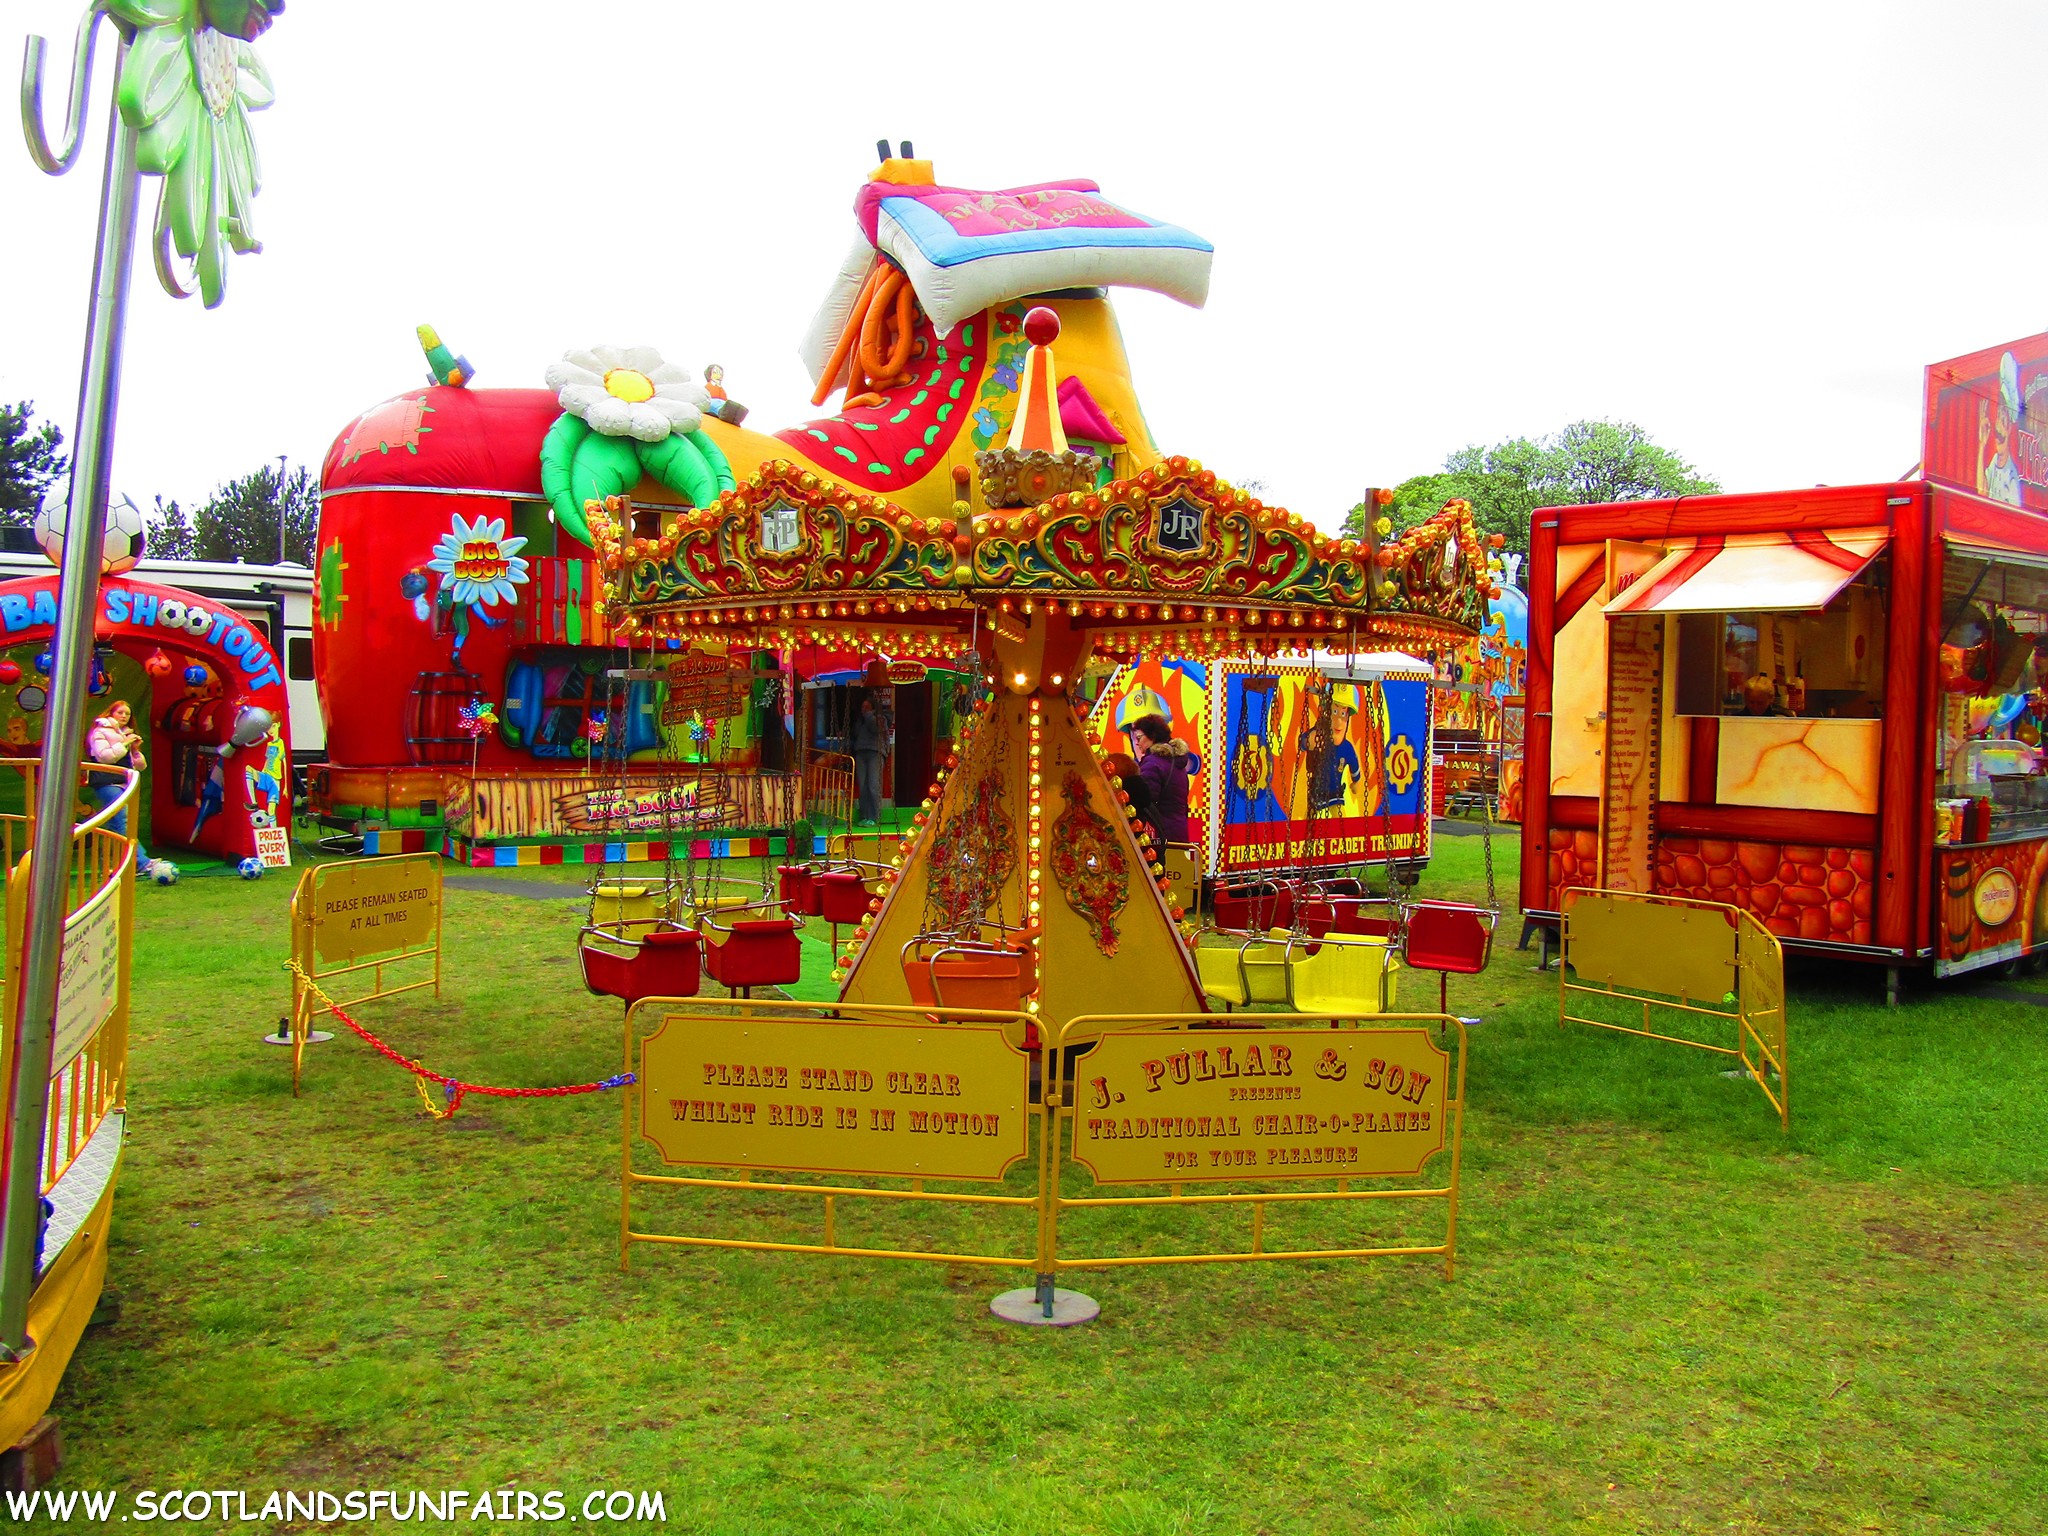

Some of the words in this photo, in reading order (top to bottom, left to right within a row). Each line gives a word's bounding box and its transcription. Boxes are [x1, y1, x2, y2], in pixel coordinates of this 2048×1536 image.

[463, 542, 499, 561] BIG
[454, 560, 510, 579] BOOT
[589, 801, 630, 821] BIG
[636, 780, 699, 815] BOOT
[628, 814, 660, 829] FUN
[258, 830, 284, 840] PRIZE
[258, 842, 286, 853] EVERY
[1229, 842, 1285, 864] FIREMAN
[1330, 836, 1366, 855] CADET
[264, 854, 286, 866] TIME
[326, 900, 359, 914] PLEASE
[362, 892, 396, 908] REMAIN
[398, 887, 428, 903] SEATED
[350, 918, 362, 931] AT
[365, 915, 381, 928] ALL
[384, 910, 408, 924] TIMES
[703, 1063, 788, 1088] PLEASE
[799, 1068, 874, 1093] STAND
[886, 1071, 962, 1096] CLEAR
[1089, 1076, 1126, 1109] J.
[1141, 1044, 1293, 1092] PULLAR
[1313, 1048, 1347, 1082] &
[1363, 1057, 1431, 1105] SON
[1229, 1086, 1302, 1101] PRESENTS
[669, 1100, 757, 1125] WHILST
[768, 1104, 824, 1129] RIDE
[836, 1106, 858, 1130] IS
[870, 1109, 896, 1132] IN
[908, 1110, 1000, 1137] MOTION
[1088, 1115, 1241, 1140] TRADITIONAL
[1252, 1111, 1432, 1136] CHAIR-O-PLANES
[1163, 1150, 1199, 1168] FOR
[1208, 1149, 1258, 1167] YOUR
[1267, 1146, 1359, 1165] PLEASURE
